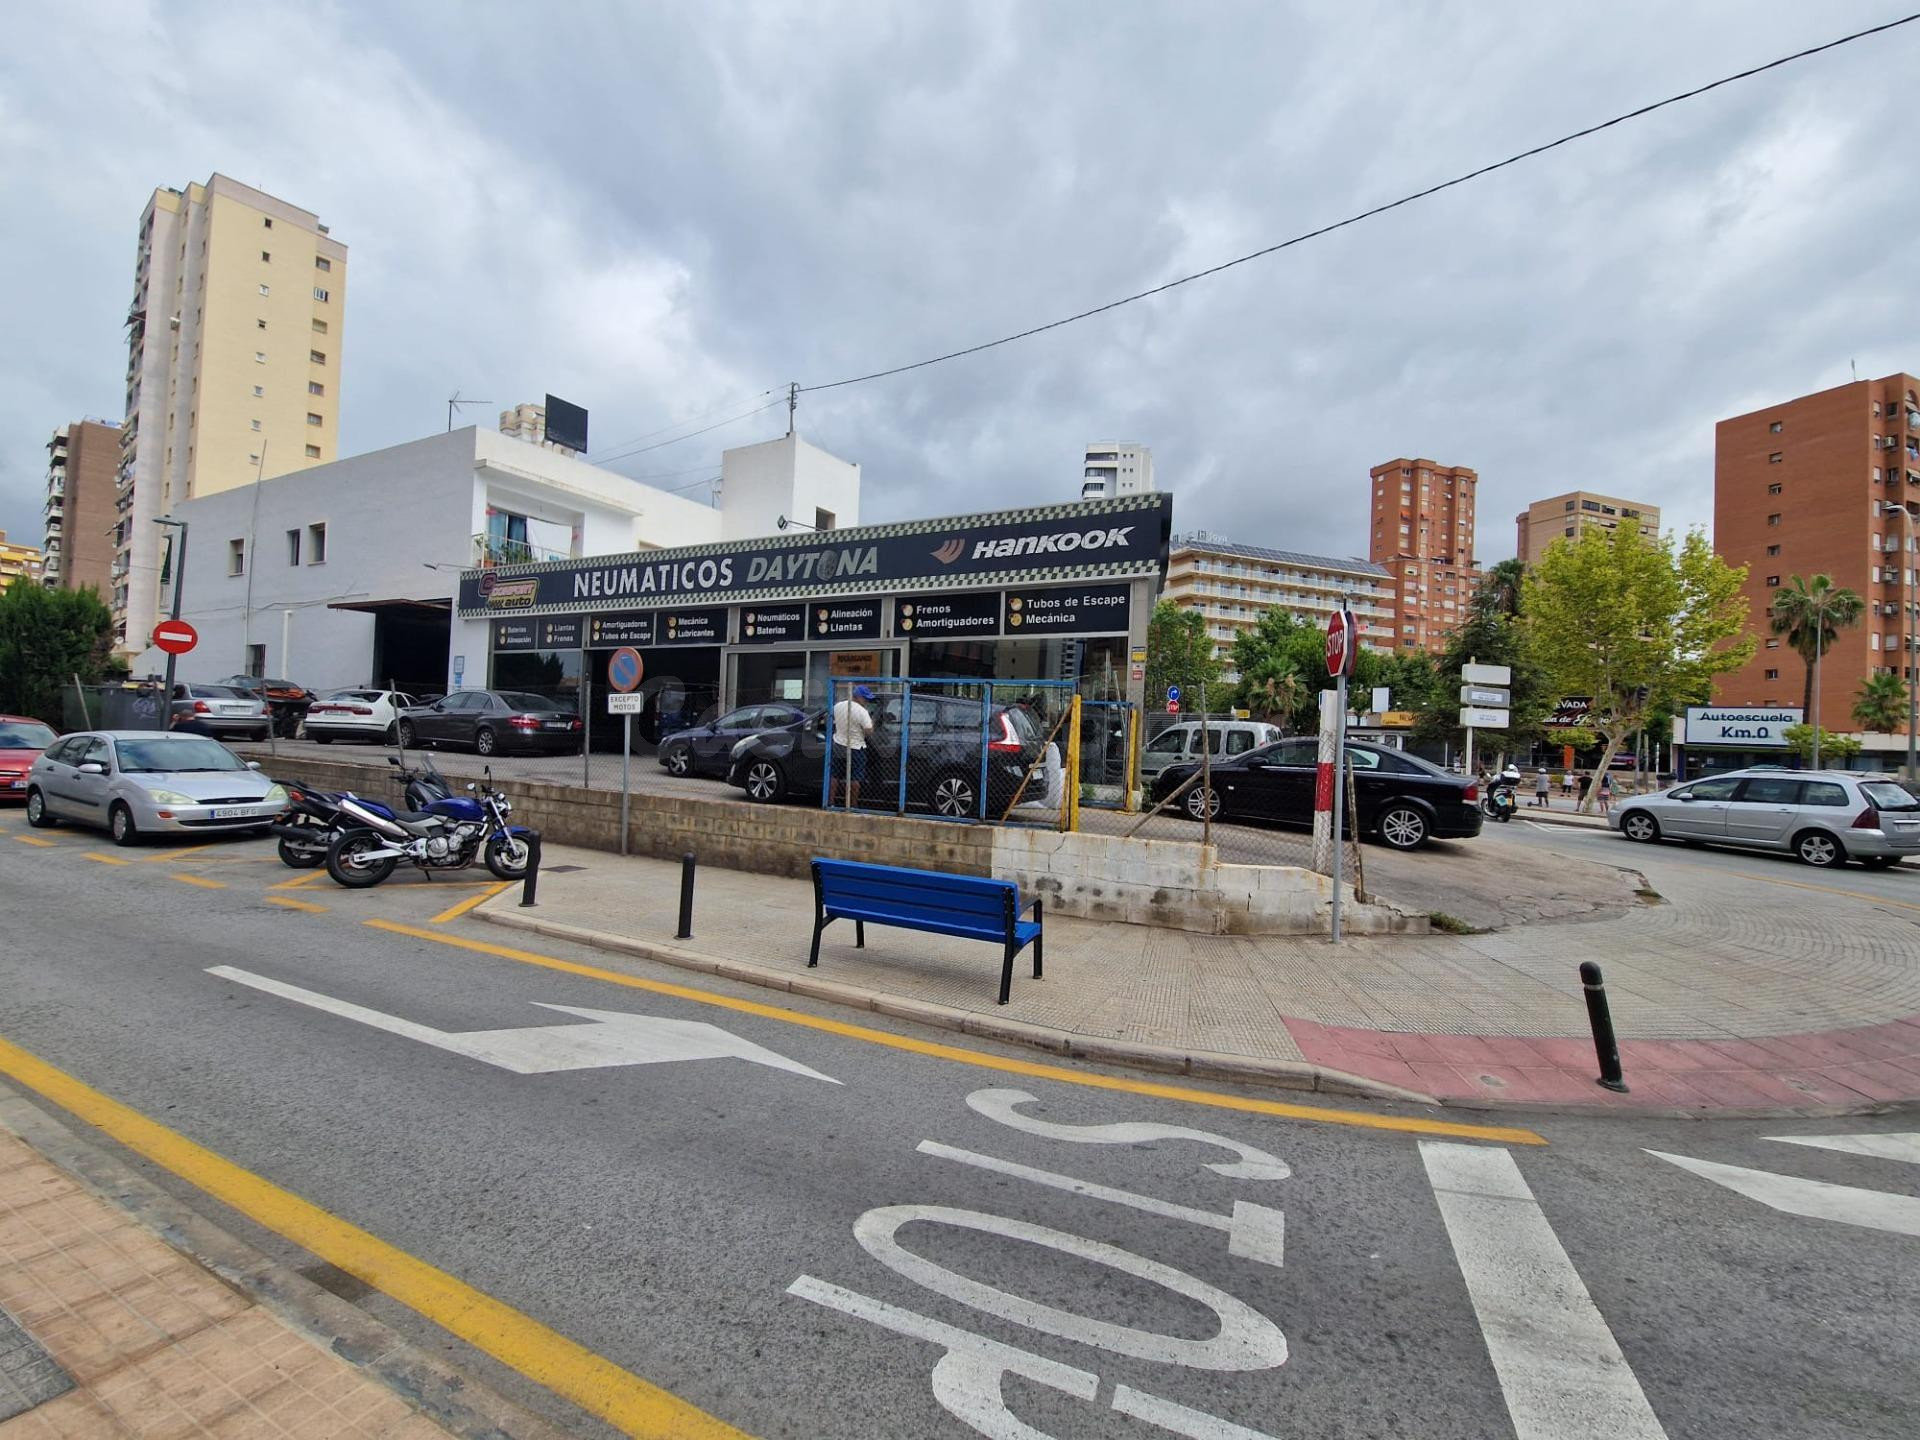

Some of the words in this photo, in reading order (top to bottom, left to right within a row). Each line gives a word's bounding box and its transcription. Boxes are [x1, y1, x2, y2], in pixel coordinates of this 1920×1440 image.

[573, 557, 734, 598] NEUMATICOS
[747, 547, 878, 583] DAYTONA
[1027, 599, 1061, 610] Tubos
[1064, 597, 1079, 608] de
[1083, 594, 1126, 607] Escape
[830, 607, 873, 618] Alineación
[916, 605, 951, 615] Frenos
[916, 615, 995, 628] Amortiguadores
[1026, 612, 1076, 625] Mecánica
[602, 620, 648, 630] Amortiguadores
[830, 622, 863, 632] Llantas
[677, 628, 715, 638] Lubricantes
[1327, 629, 1344, 657] STOP
[610, 695, 640, 703] EXCEPTO
[1699, 711, 1794, 723] Autoescuela
[1721, 726, 1769, 739] Km.0
